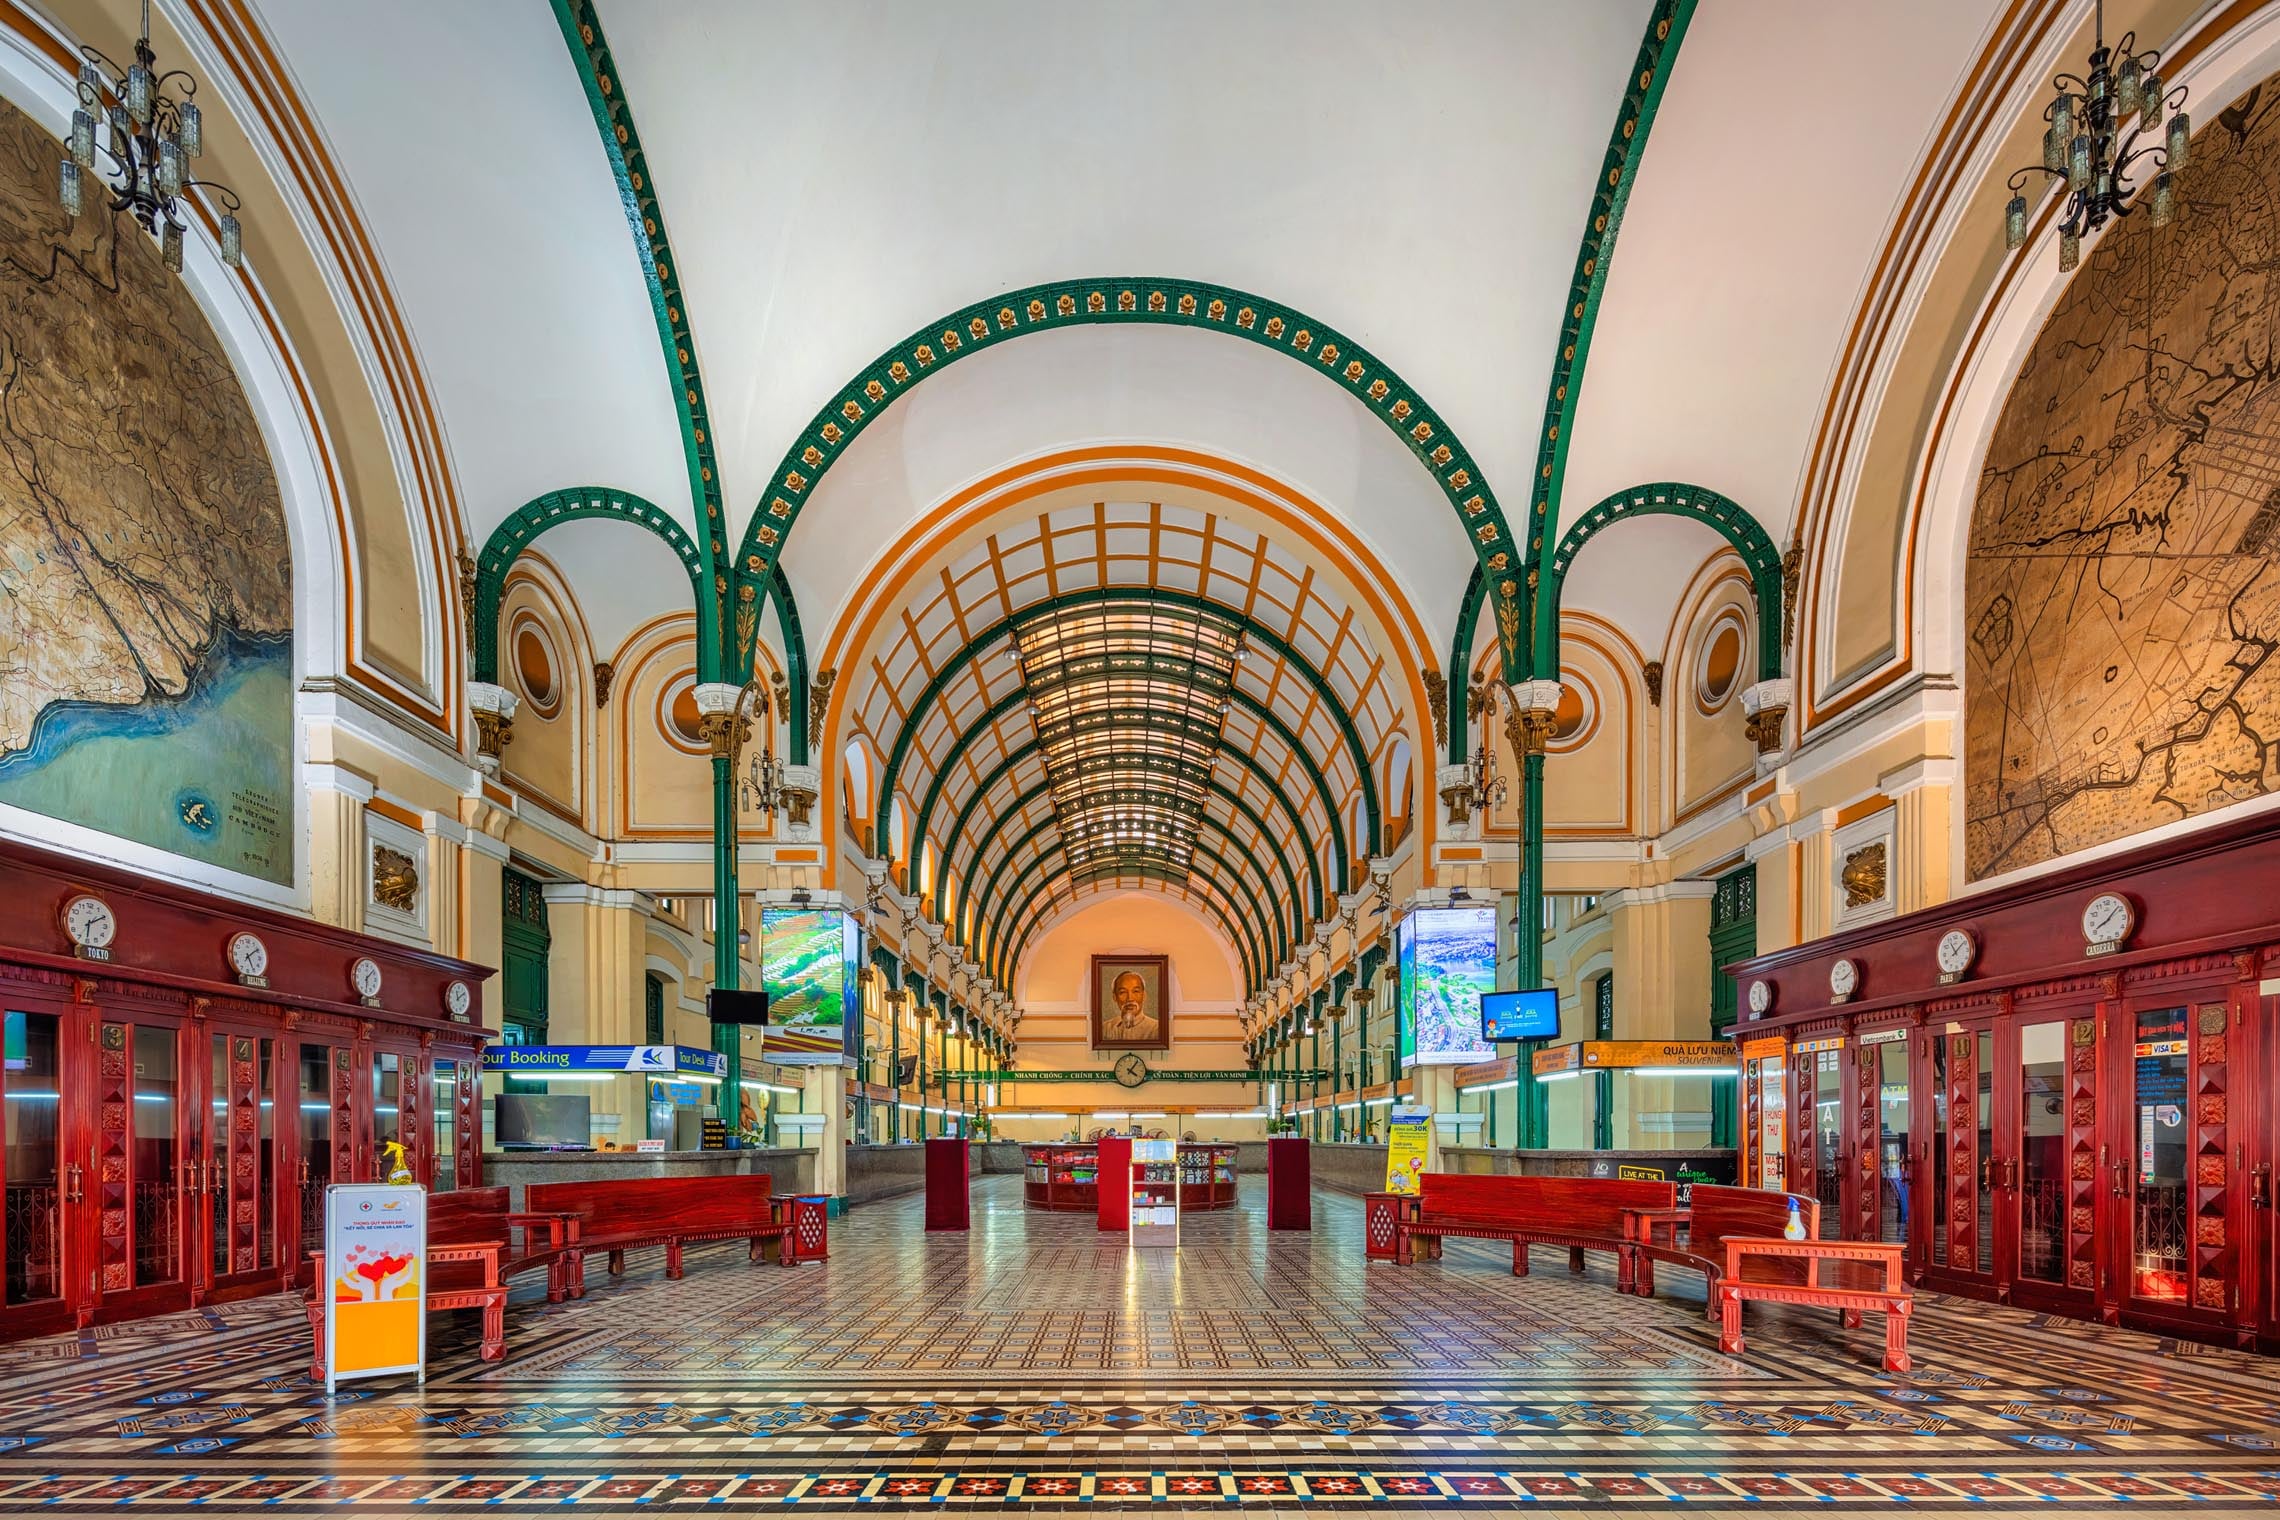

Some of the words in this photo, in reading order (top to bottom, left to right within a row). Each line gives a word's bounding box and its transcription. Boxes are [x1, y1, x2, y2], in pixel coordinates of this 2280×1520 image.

[87, 947, 109, 961] TOKYO
[2086, 940, 2116, 957] CANBERRA
[109, 1027, 123, 1047] 3
[2073, 1023, 2093, 1043] 12
[1862, 1034, 1896, 1045] Vietcombank
[239, 1041, 248, 1058] 4
[1663, 1044, 1685, 1056] QUÀ
[1687, 1045, 1708, 1055] LƯU
[2153, 1044, 2170, 1053] VISA
[482, 1053, 504, 1065] our
[510, 1051, 570, 1067] Booking
[680, 1051, 691, 1063] Tour
[692, 1054, 705, 1066] Desk
[1677, 1056, 1722, 1065] SOUVENIR
[1039, 1071, 1063, 1079] CHÓNG
[1070, 1071, 1093, 1079] CHÍNH
[1095, 1071, 1110, 1079] XÁC
[1162, 1071, 1179, 1079] TOÀN
[1881, 1085, 1908, 1096] ATM
[1680, 1162, 1688, 1172] A
[1623, 1170, 1637, 1179] LIVE
[1646, 1173, 1659, 1181] THE
